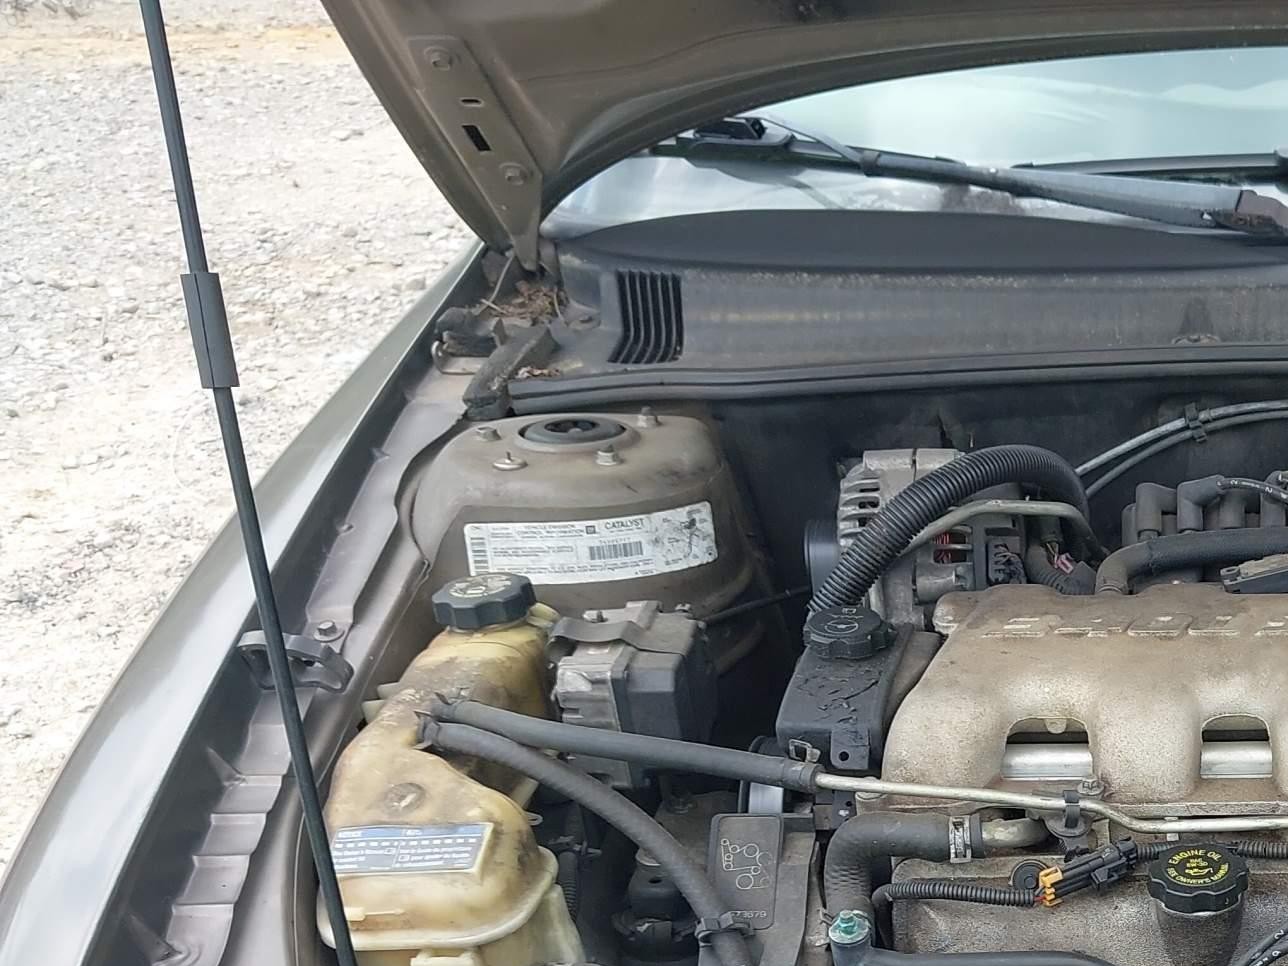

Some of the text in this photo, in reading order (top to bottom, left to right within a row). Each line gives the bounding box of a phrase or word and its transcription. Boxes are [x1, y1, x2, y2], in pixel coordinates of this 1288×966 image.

[604, 518, 645, 530] CATALYST
[1168, 849, 1222, 864] ENGINE OIL
